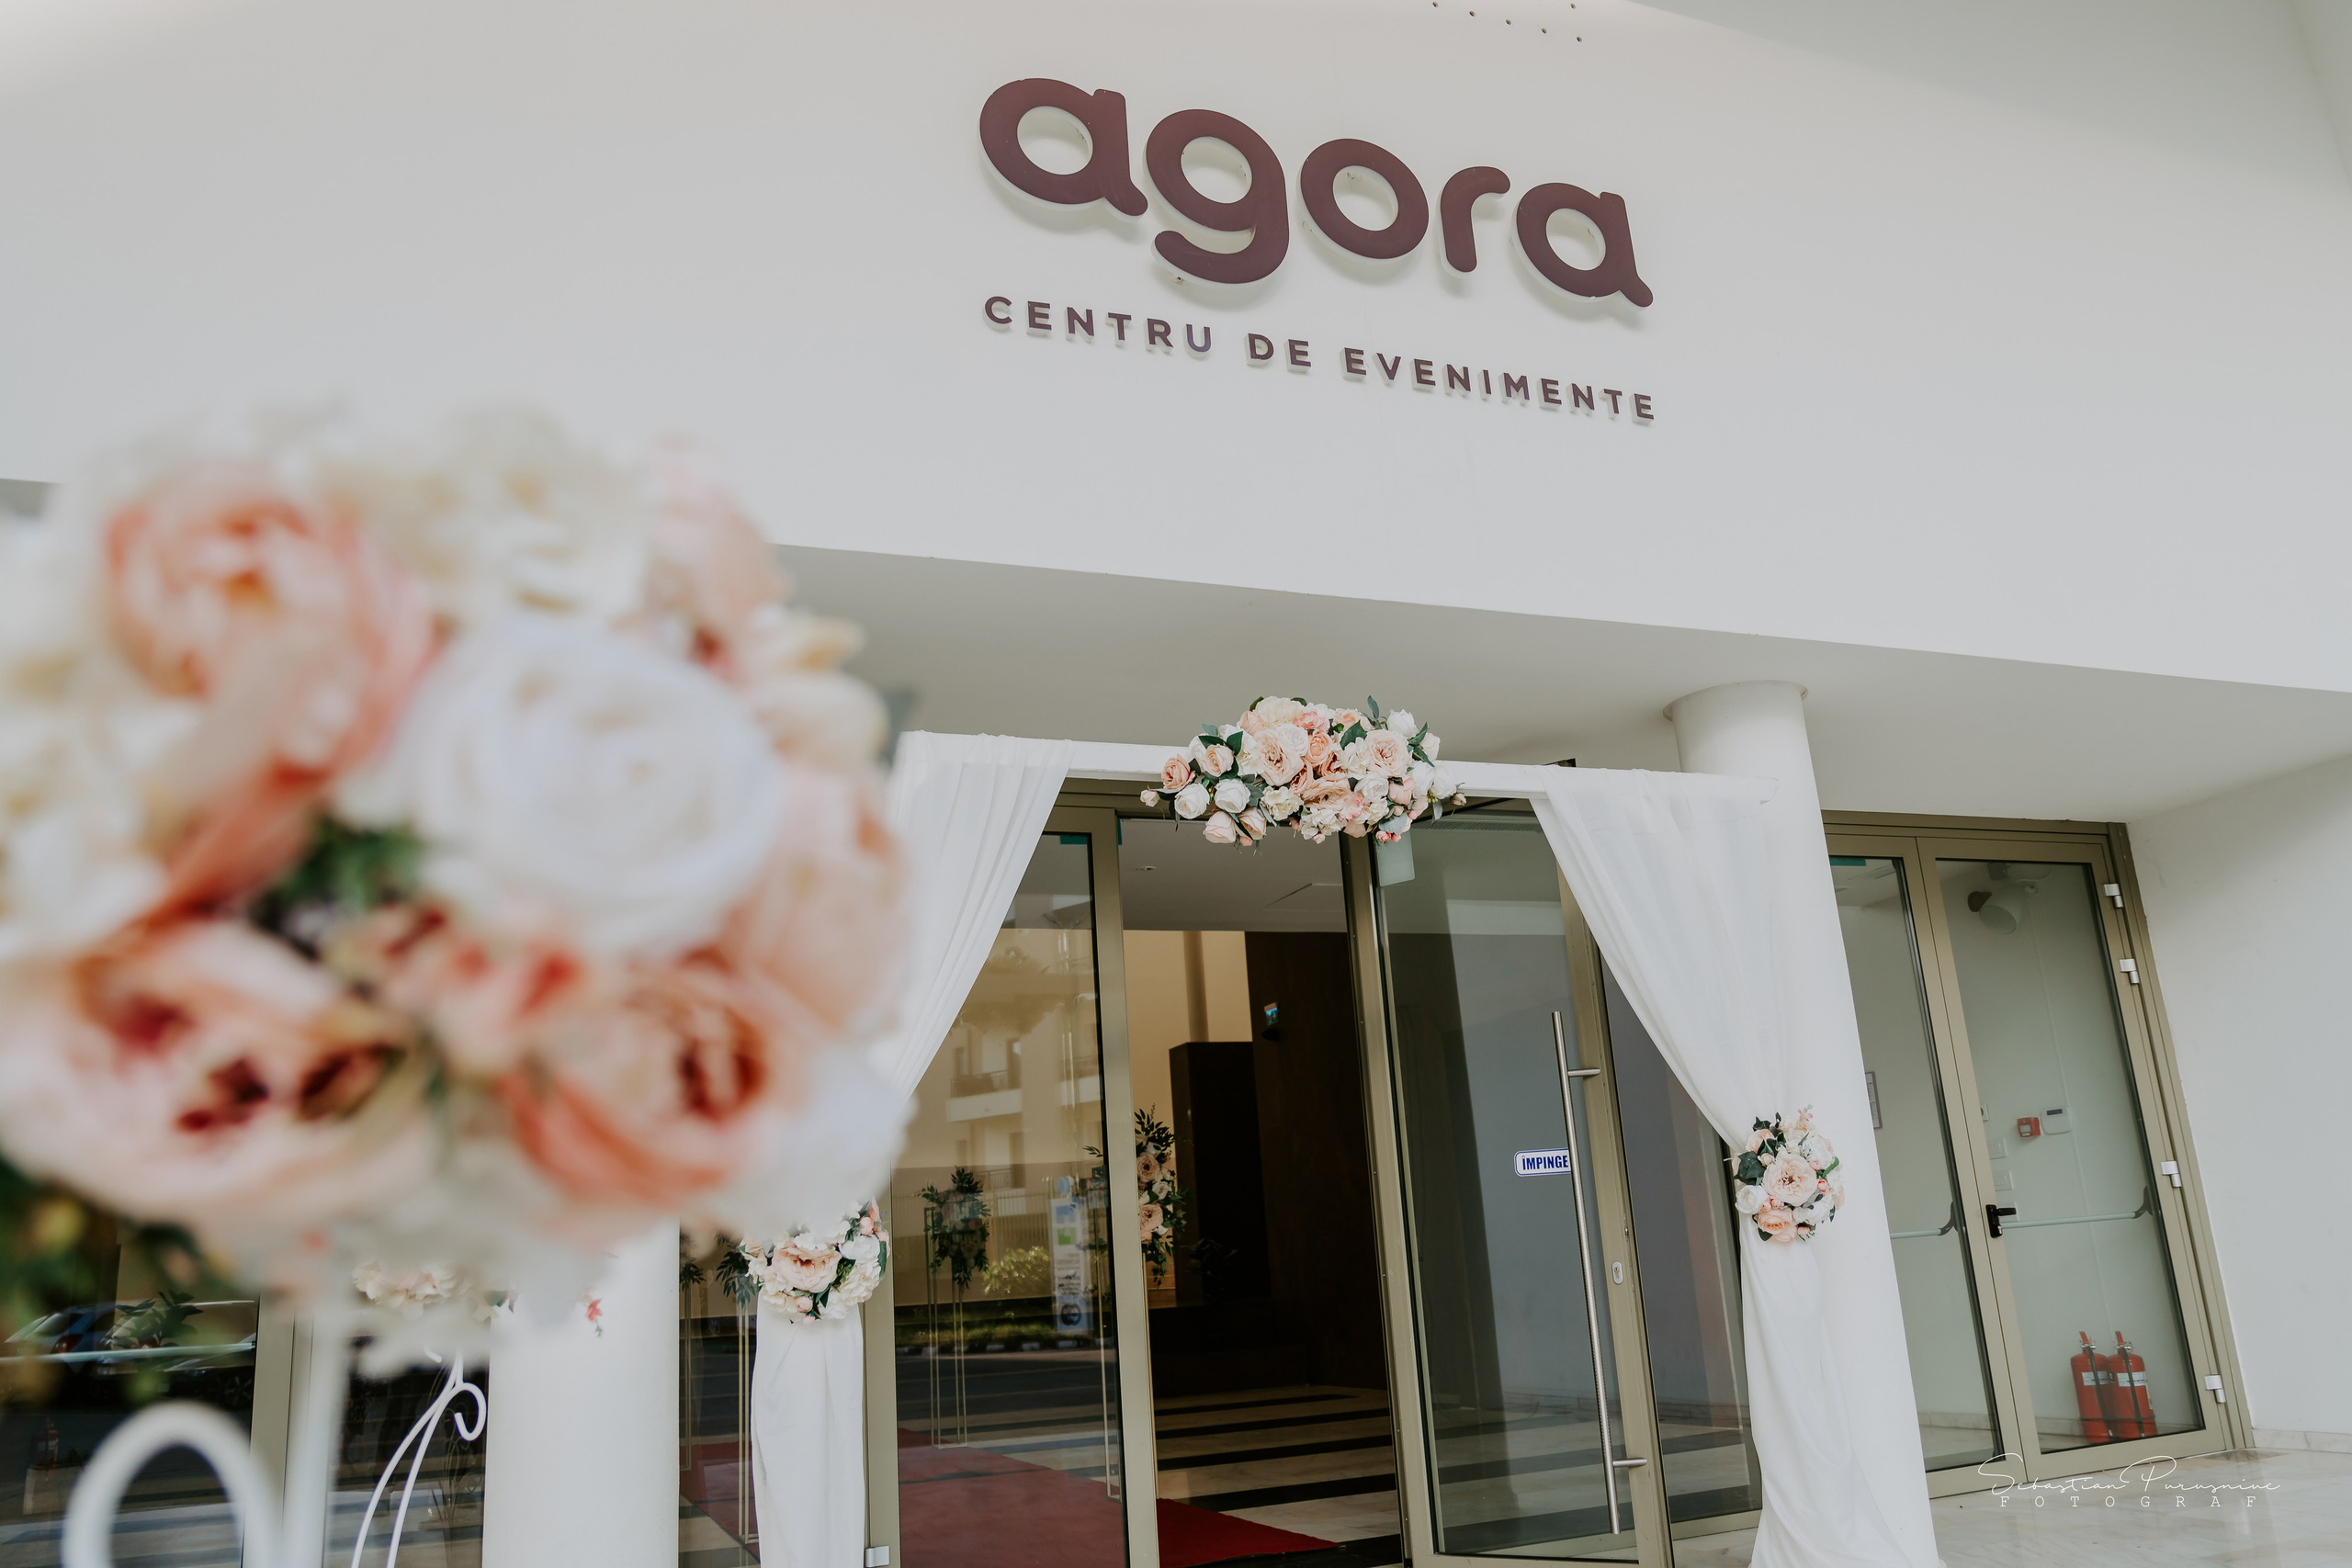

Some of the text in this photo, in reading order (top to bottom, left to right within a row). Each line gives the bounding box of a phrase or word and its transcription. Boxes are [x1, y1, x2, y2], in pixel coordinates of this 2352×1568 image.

[979, 77, 1654, 308] agora
[985, 296, 1655, 420] CENTRU DE EVENIMENTE
